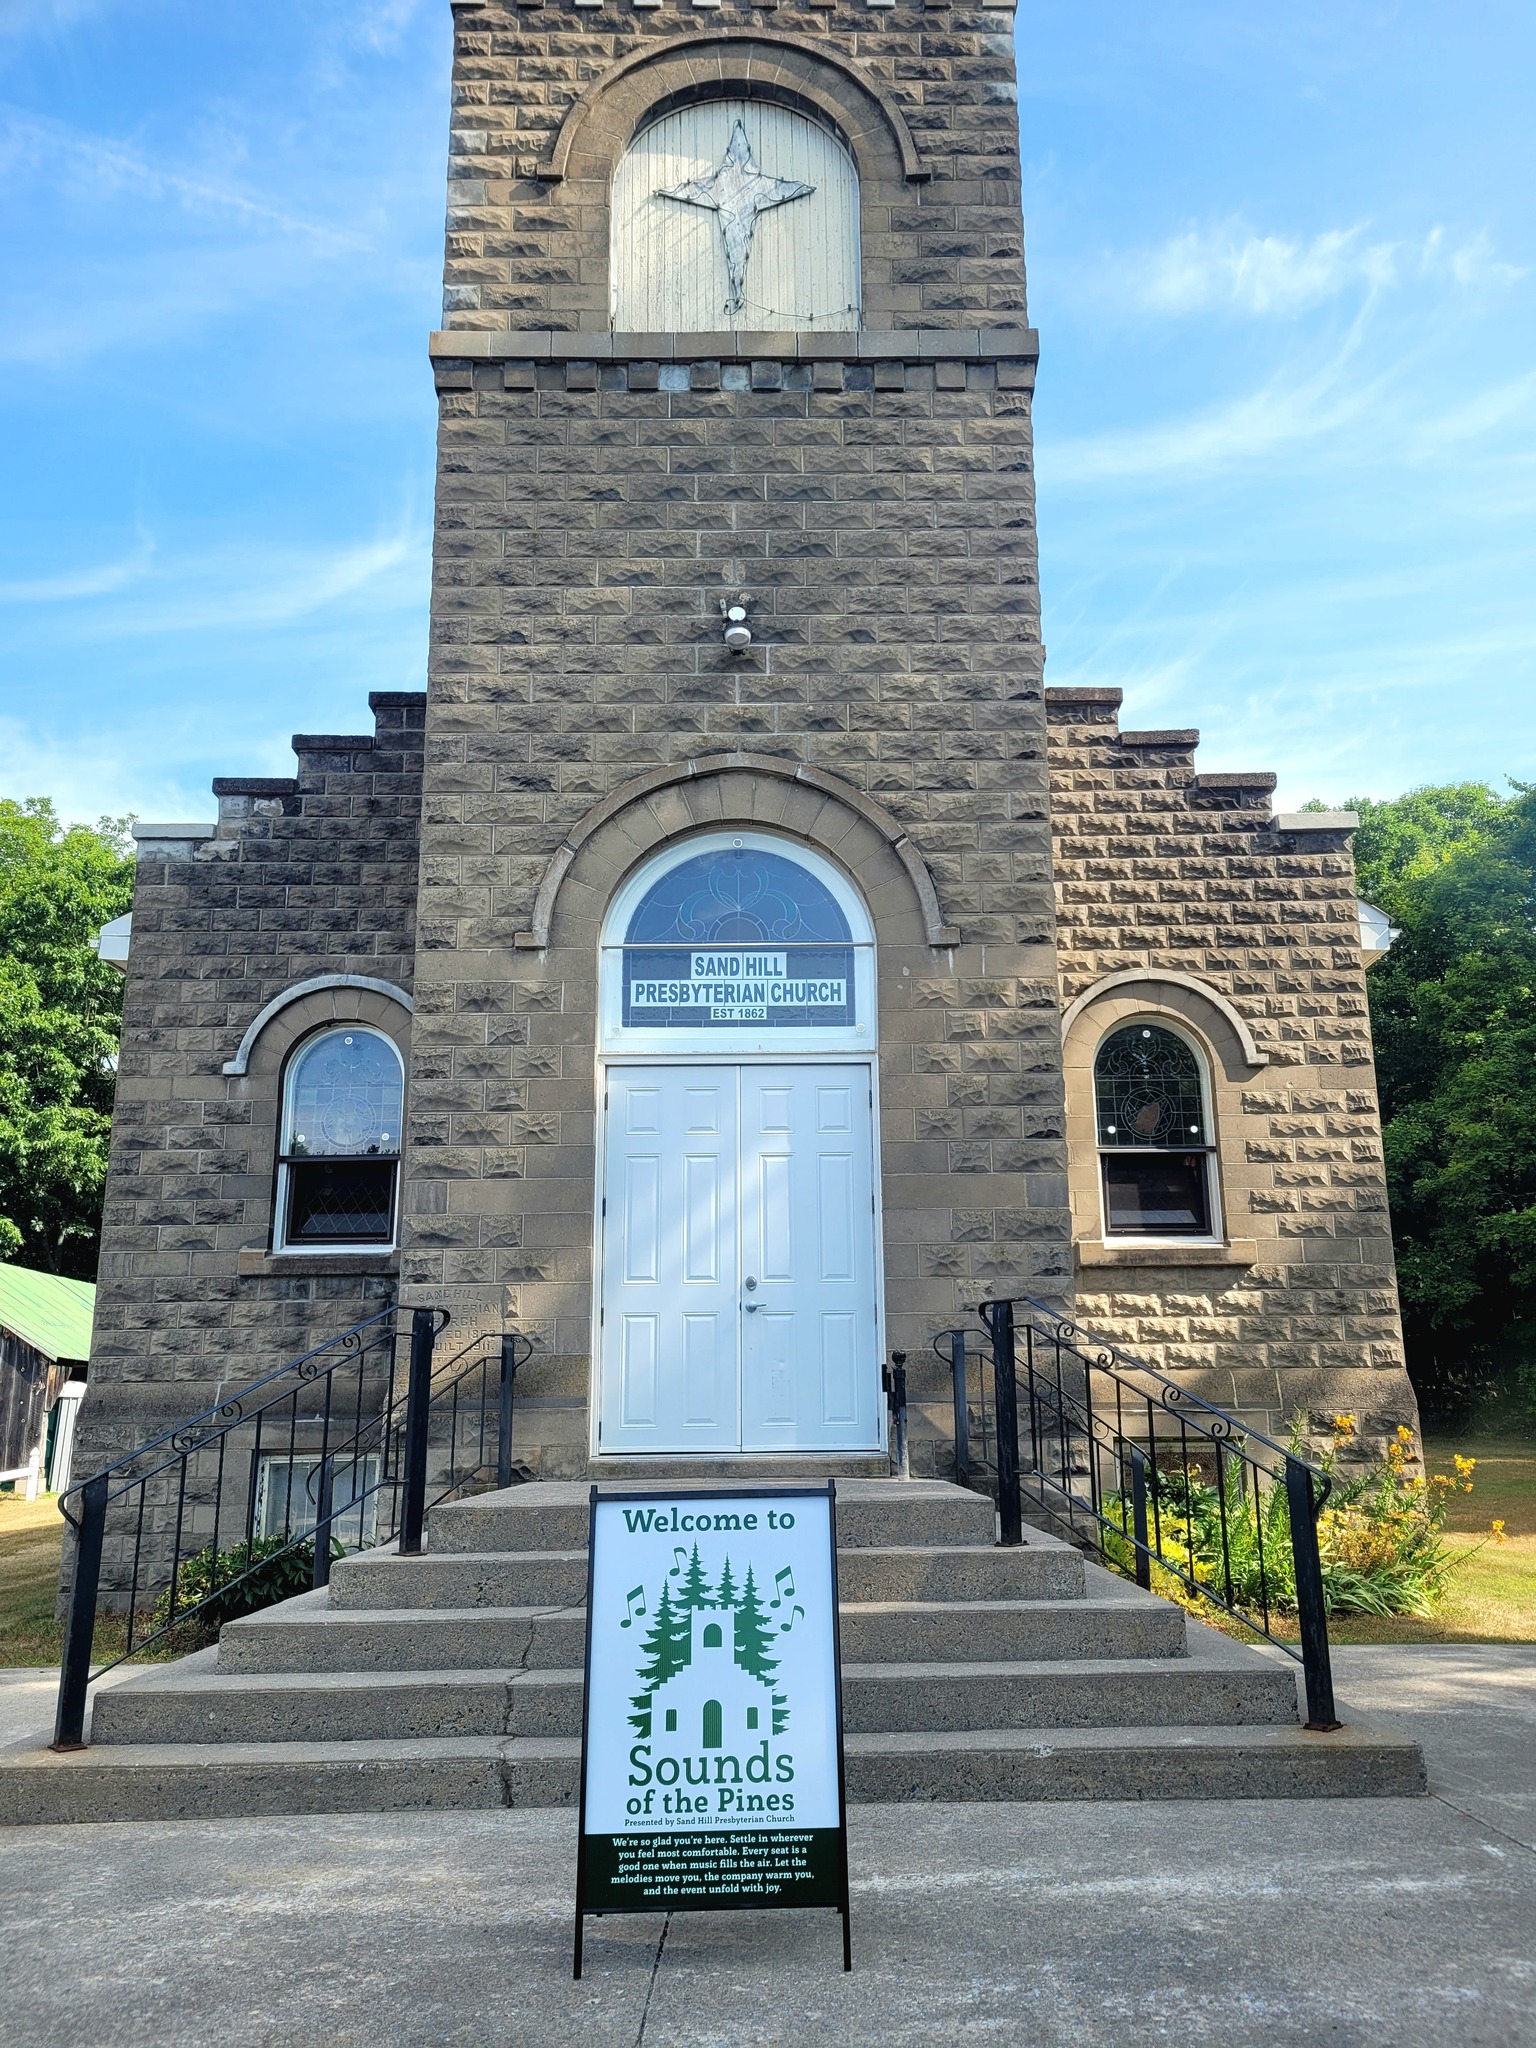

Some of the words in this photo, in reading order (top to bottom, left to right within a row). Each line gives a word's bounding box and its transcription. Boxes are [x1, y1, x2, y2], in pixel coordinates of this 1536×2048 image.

[695, 956, 740, 976] SAND
[746, 957, 783, 976] HILL
[635, 983, 765, 1003] PRESBYTERIAN
[771, 982, 841, 1003] CHURCH
[713, 1008, 735, 1018] EST
[738, 1008, 764, 1018] 1862
[417, 1289, 450, 1303] SAND
[453, 1289, 483, 1302] HILL
[622, 1507, 758, 1533] Welcome
[767, 1510, 795, 1530] to
[628, 1740, 794, 1786] Sounds
[626, 1789, 656, 1815] of
[663, 1788, 708, 1814] the
[718, 1788, 794, 1812] Pines
[625, 1818, 663, 1826] Presented
[665, 1817, 675, 1827] by
[676, 1817, 695, 1825] Sand
[698, 1816, 712, 1824] Hill
[715, 1816, 764, 1825] Presbyterian
[766, 1814, 795, 1822] Church
[612, 1837, 638, 1846] We're
[652, 1836, 672, 1848] glad
[674, 1835, 702, 1847] you're
[705, 1835, 728, 1844] here.
[730, 1834, 756, 1843] Settle
[758, 1834, 768, 1842] in
[770, 1833, 813, 1842] wherever
[618, 1852, 635, 1861] you
[638, 1849, 655, 1858] feel
[682, 1846, 740, 1857] comfortable.
[742, 1846, 769, 1857] Every
[792, 1845, 800, 1854] is
[618, 1861, 640, 1873] good
[661, 1860, 687, 1870] when
[690, 1860, 717, 1869] music
[720, 1859, 737, 1868] fills
[740, 1858, 755, 1867] the
[757, 1858, 772, 1867] air.
[775, 1858, 789, 1867] Let
[791, 1857, 807, 1866] the
[611, 1874, 653, 1884] melodies
[682, 1875, 702, 1884] you,
[704, 1872, 719, 1881] the
[721, 1873, 763, 1882] company
[794, 1872, 814, 1881] you,
[643, 1885, 661, 1895] and
[663, 1885, 679, 1895] the
[681, 1886, 706, 1894] event
[709, 1883, 739, 1893] unfold
[742, 1883, 763, 1892] with
[765, 1883, 782, 1894] joy.
